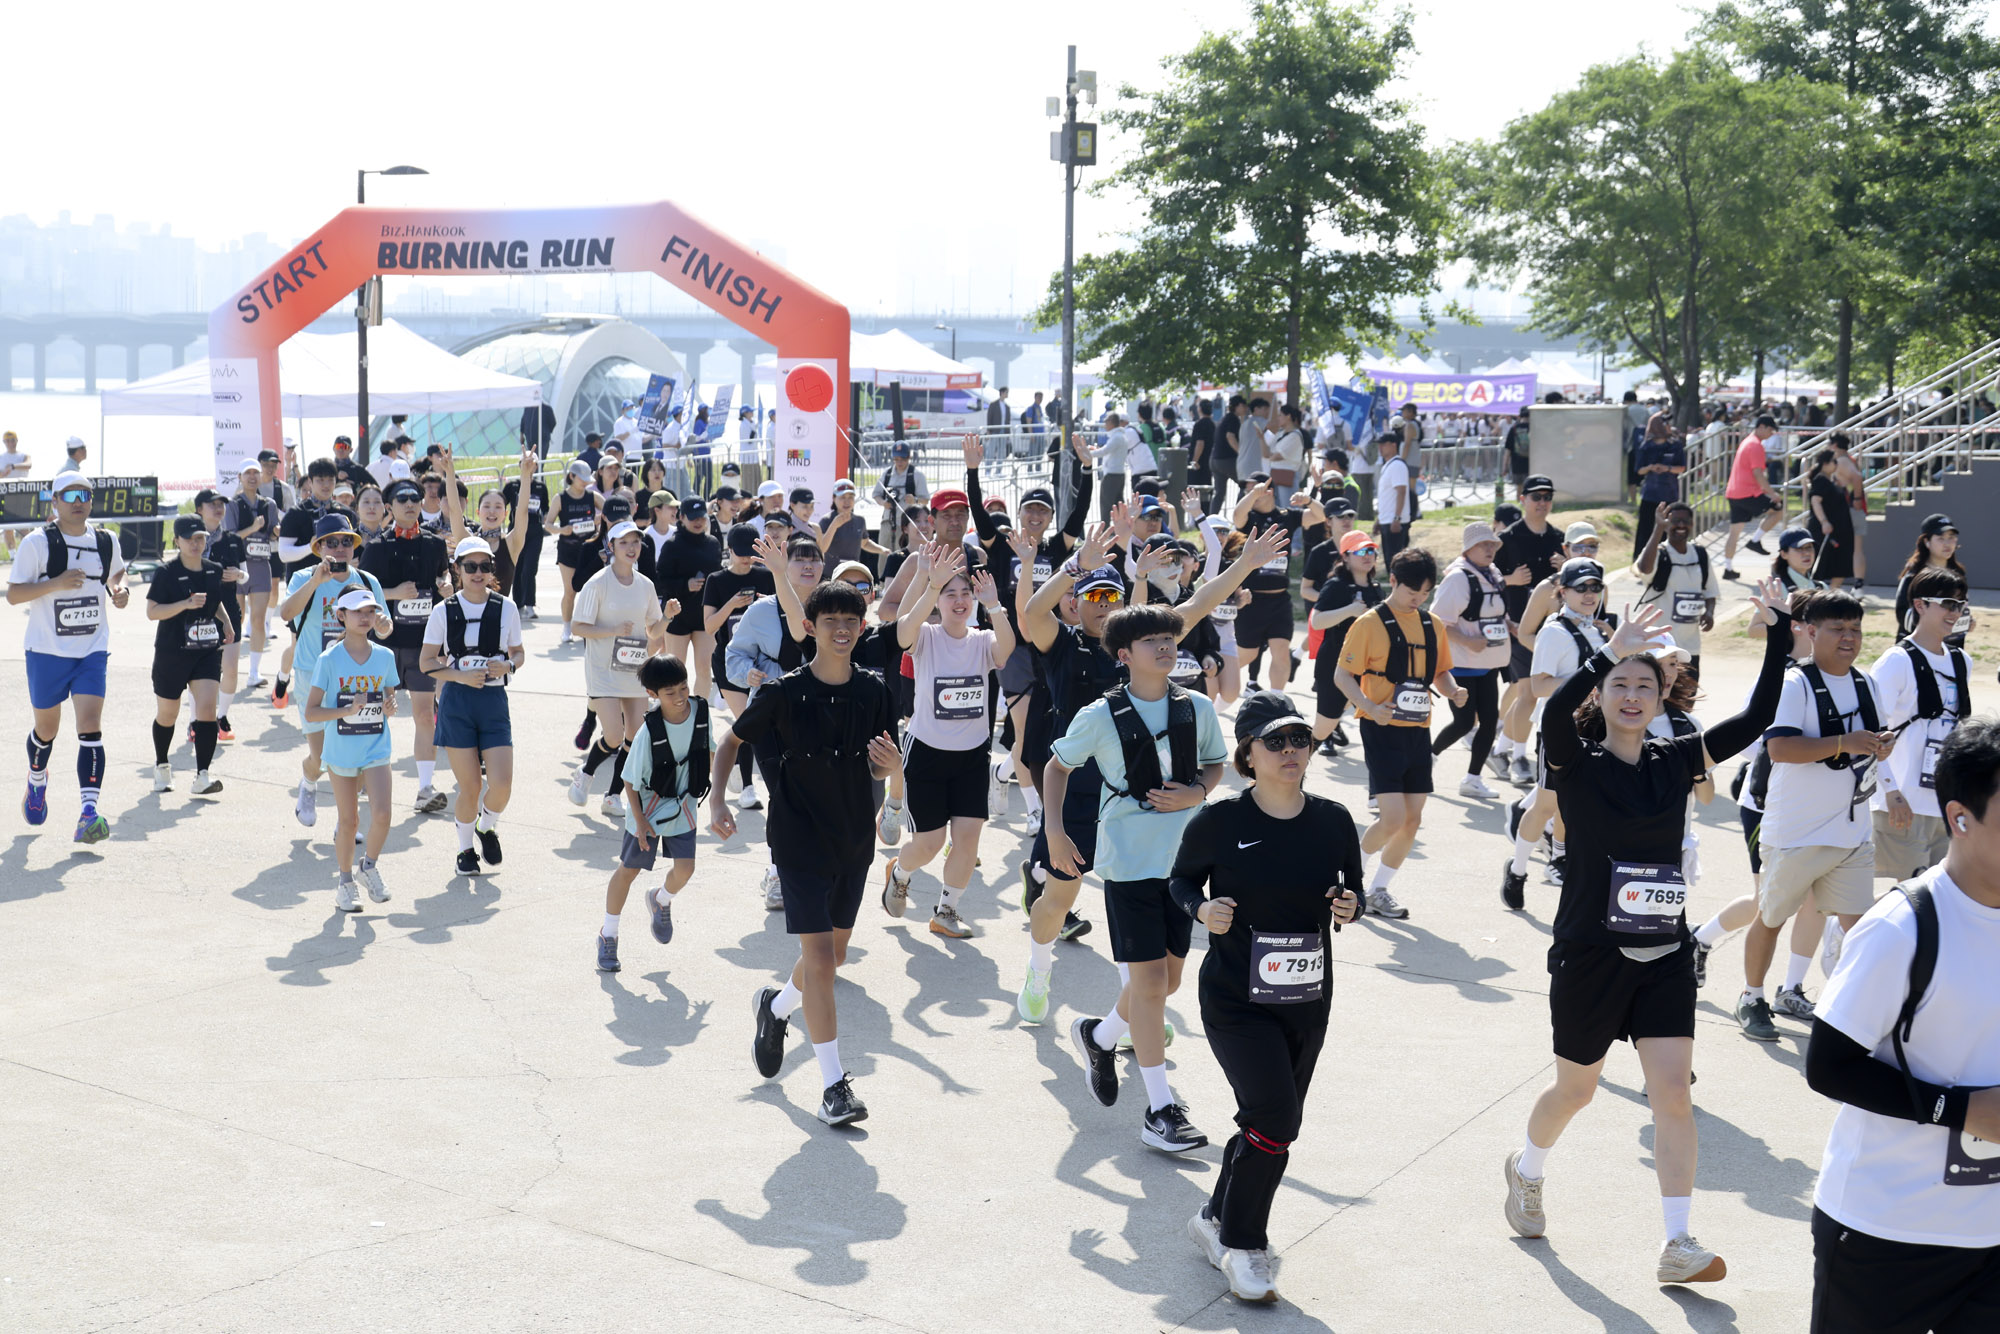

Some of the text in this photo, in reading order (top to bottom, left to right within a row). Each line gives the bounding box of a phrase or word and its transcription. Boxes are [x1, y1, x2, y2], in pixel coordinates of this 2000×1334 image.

[378, 237, 615, 269] BURNING RUN
[237, 239, 328, 324] START
[661, 235, 783, 324] FINISH
[787, 459, 811, 467] KIND
[8, 482, 49, 492] SAMIK
[97, 478, 141, 488] SAMIK
[74, 609, 99, 620] 7133
[955, 690, 982, 701] 7975
[1402, 695, 1410, 703] M
[1626, 888, 1686, 905] W 7695
[1257, 936, 1304, 945] BURNING RUN
[1267, 954, 1323, 973] W 7913
